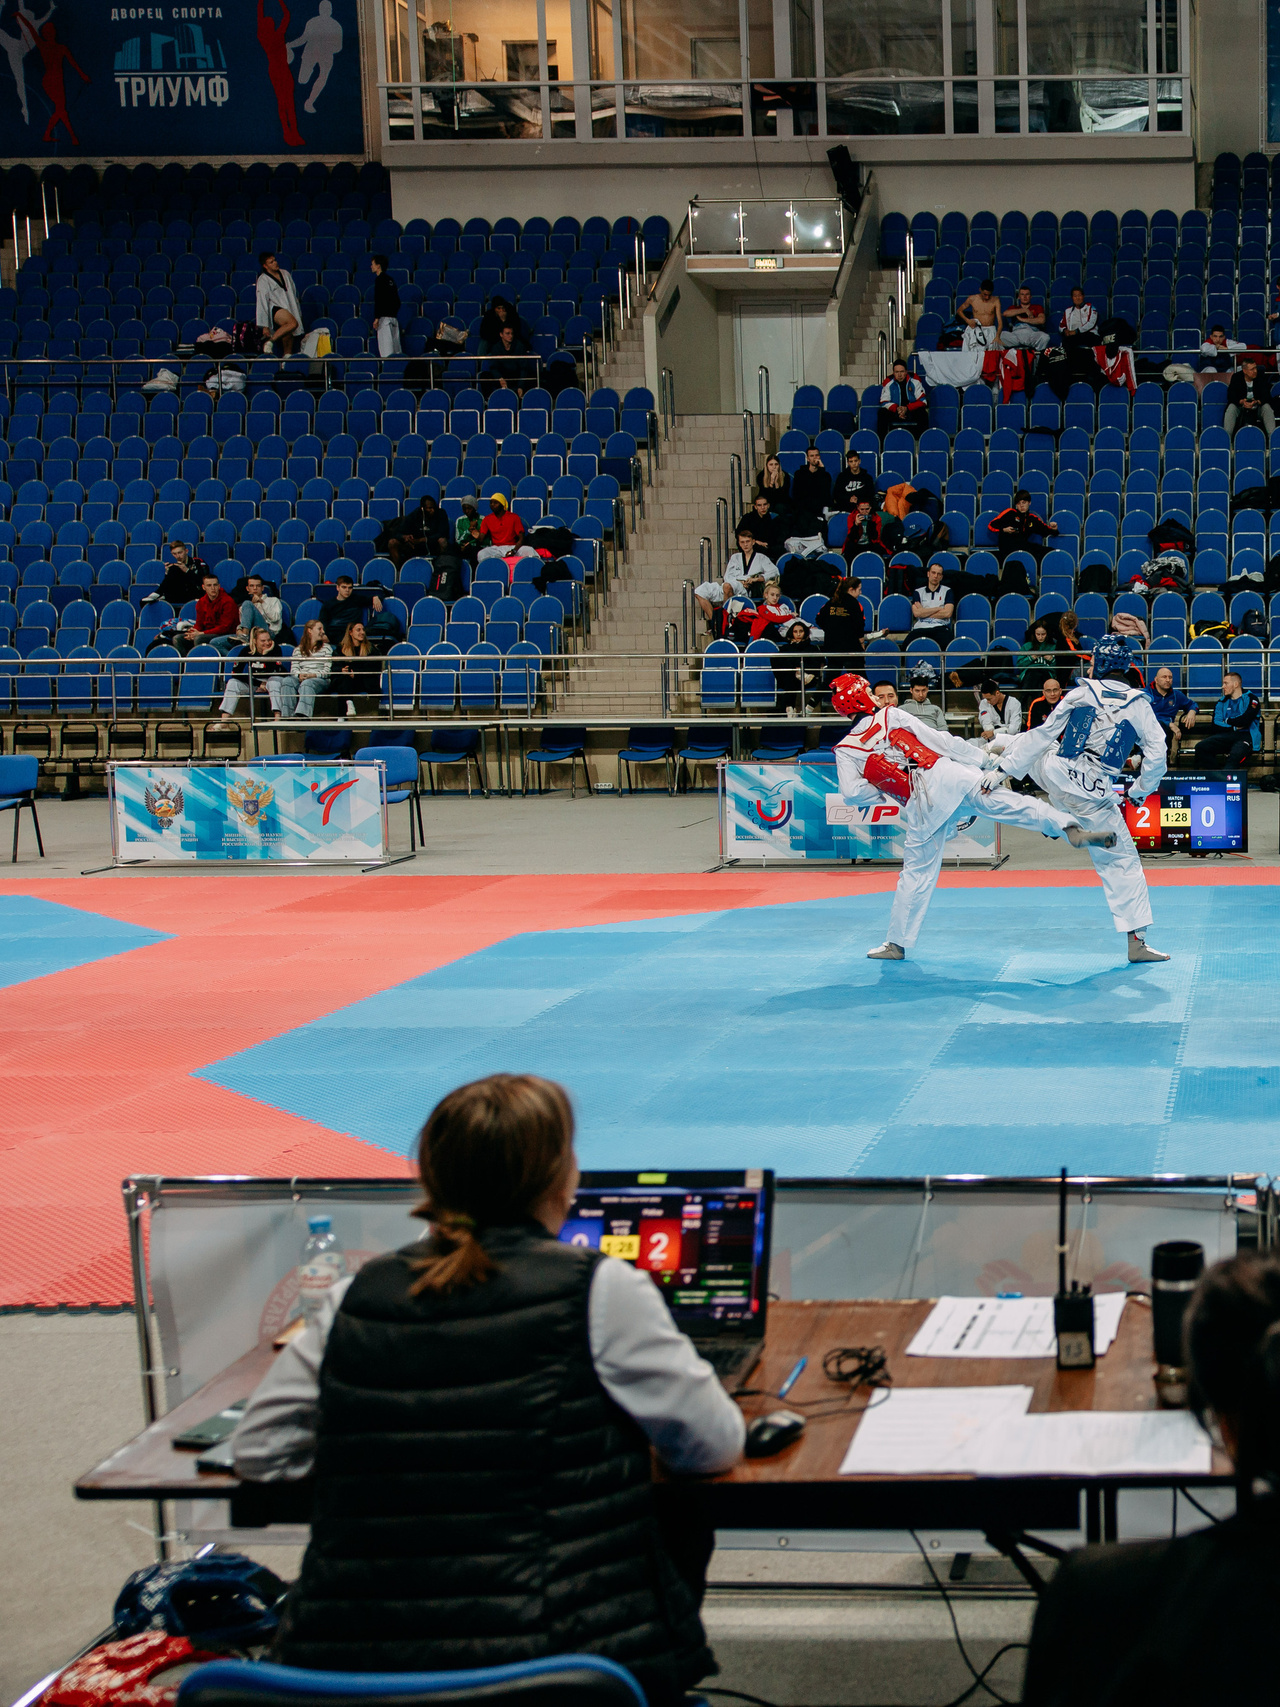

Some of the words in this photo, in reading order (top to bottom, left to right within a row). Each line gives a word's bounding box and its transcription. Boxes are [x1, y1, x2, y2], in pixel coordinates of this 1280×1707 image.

[111, 8, 163, 21] ДВОРЕЦ
[172, 7, 222, 19] СПОРТА
[114, 75, 230, 107] ТРИУМФ
[1136, 806, 1151, 828] 2
[1164, 813, 1188, 822] 1:28
[1201, 806, 1216, 828] 0
[648, 1231, 670, 1261] 2
